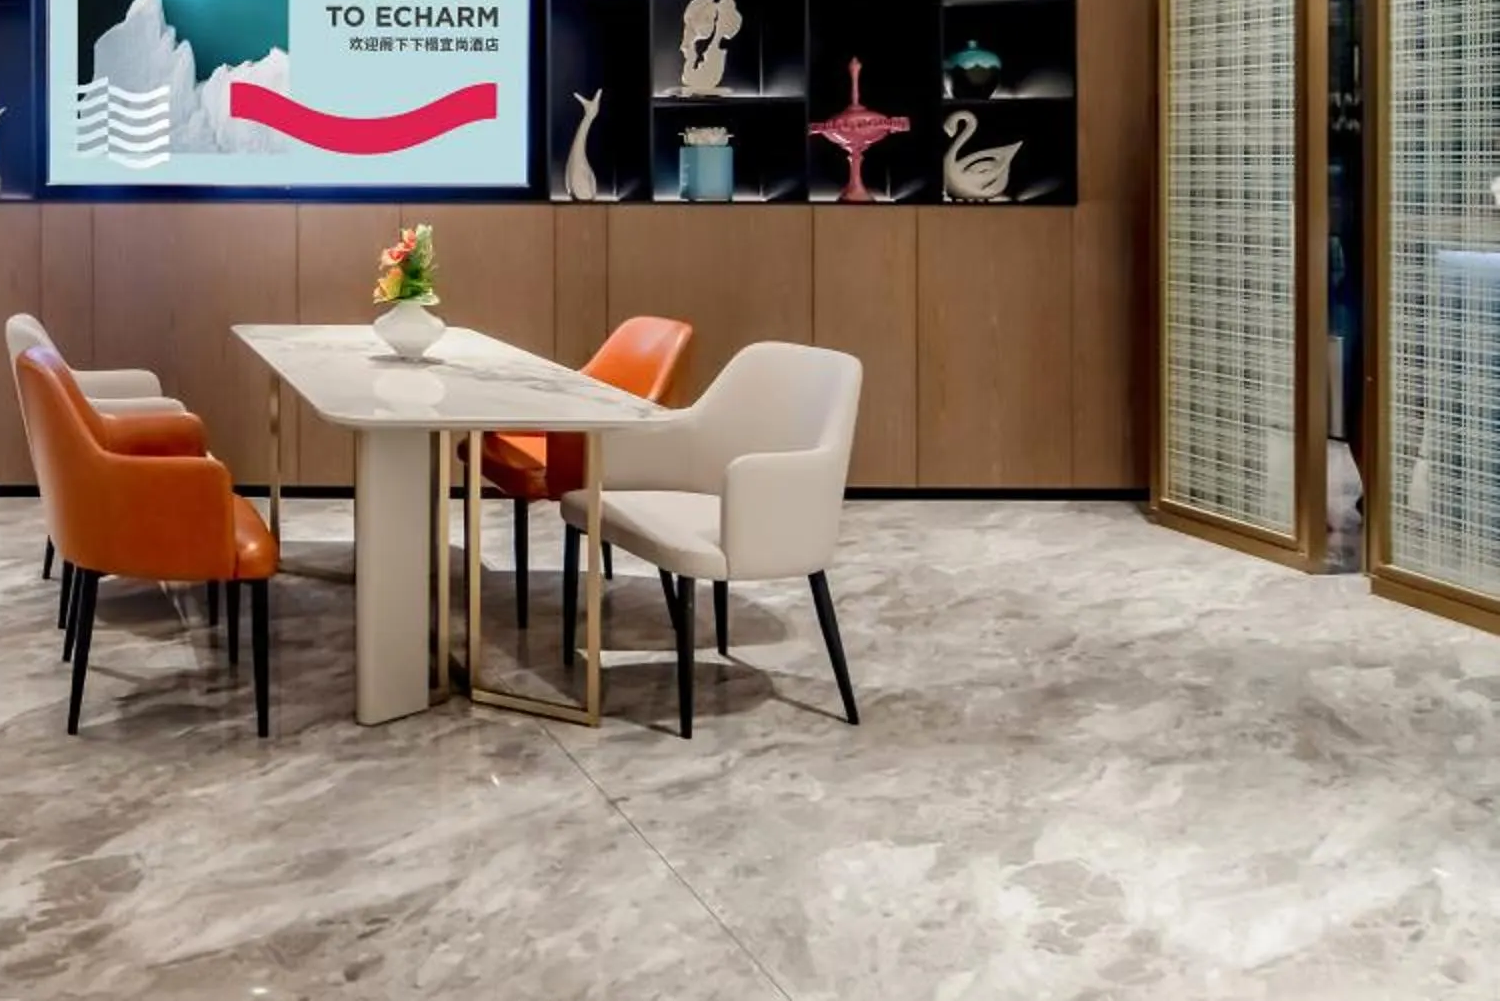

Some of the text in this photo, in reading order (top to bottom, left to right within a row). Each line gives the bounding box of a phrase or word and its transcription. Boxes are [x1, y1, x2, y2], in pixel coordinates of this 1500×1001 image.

[326, 6, 499, 27] TO ECHARM
[350, 37, 499, 52] 欢迎阁下下榻宜尚酒店
